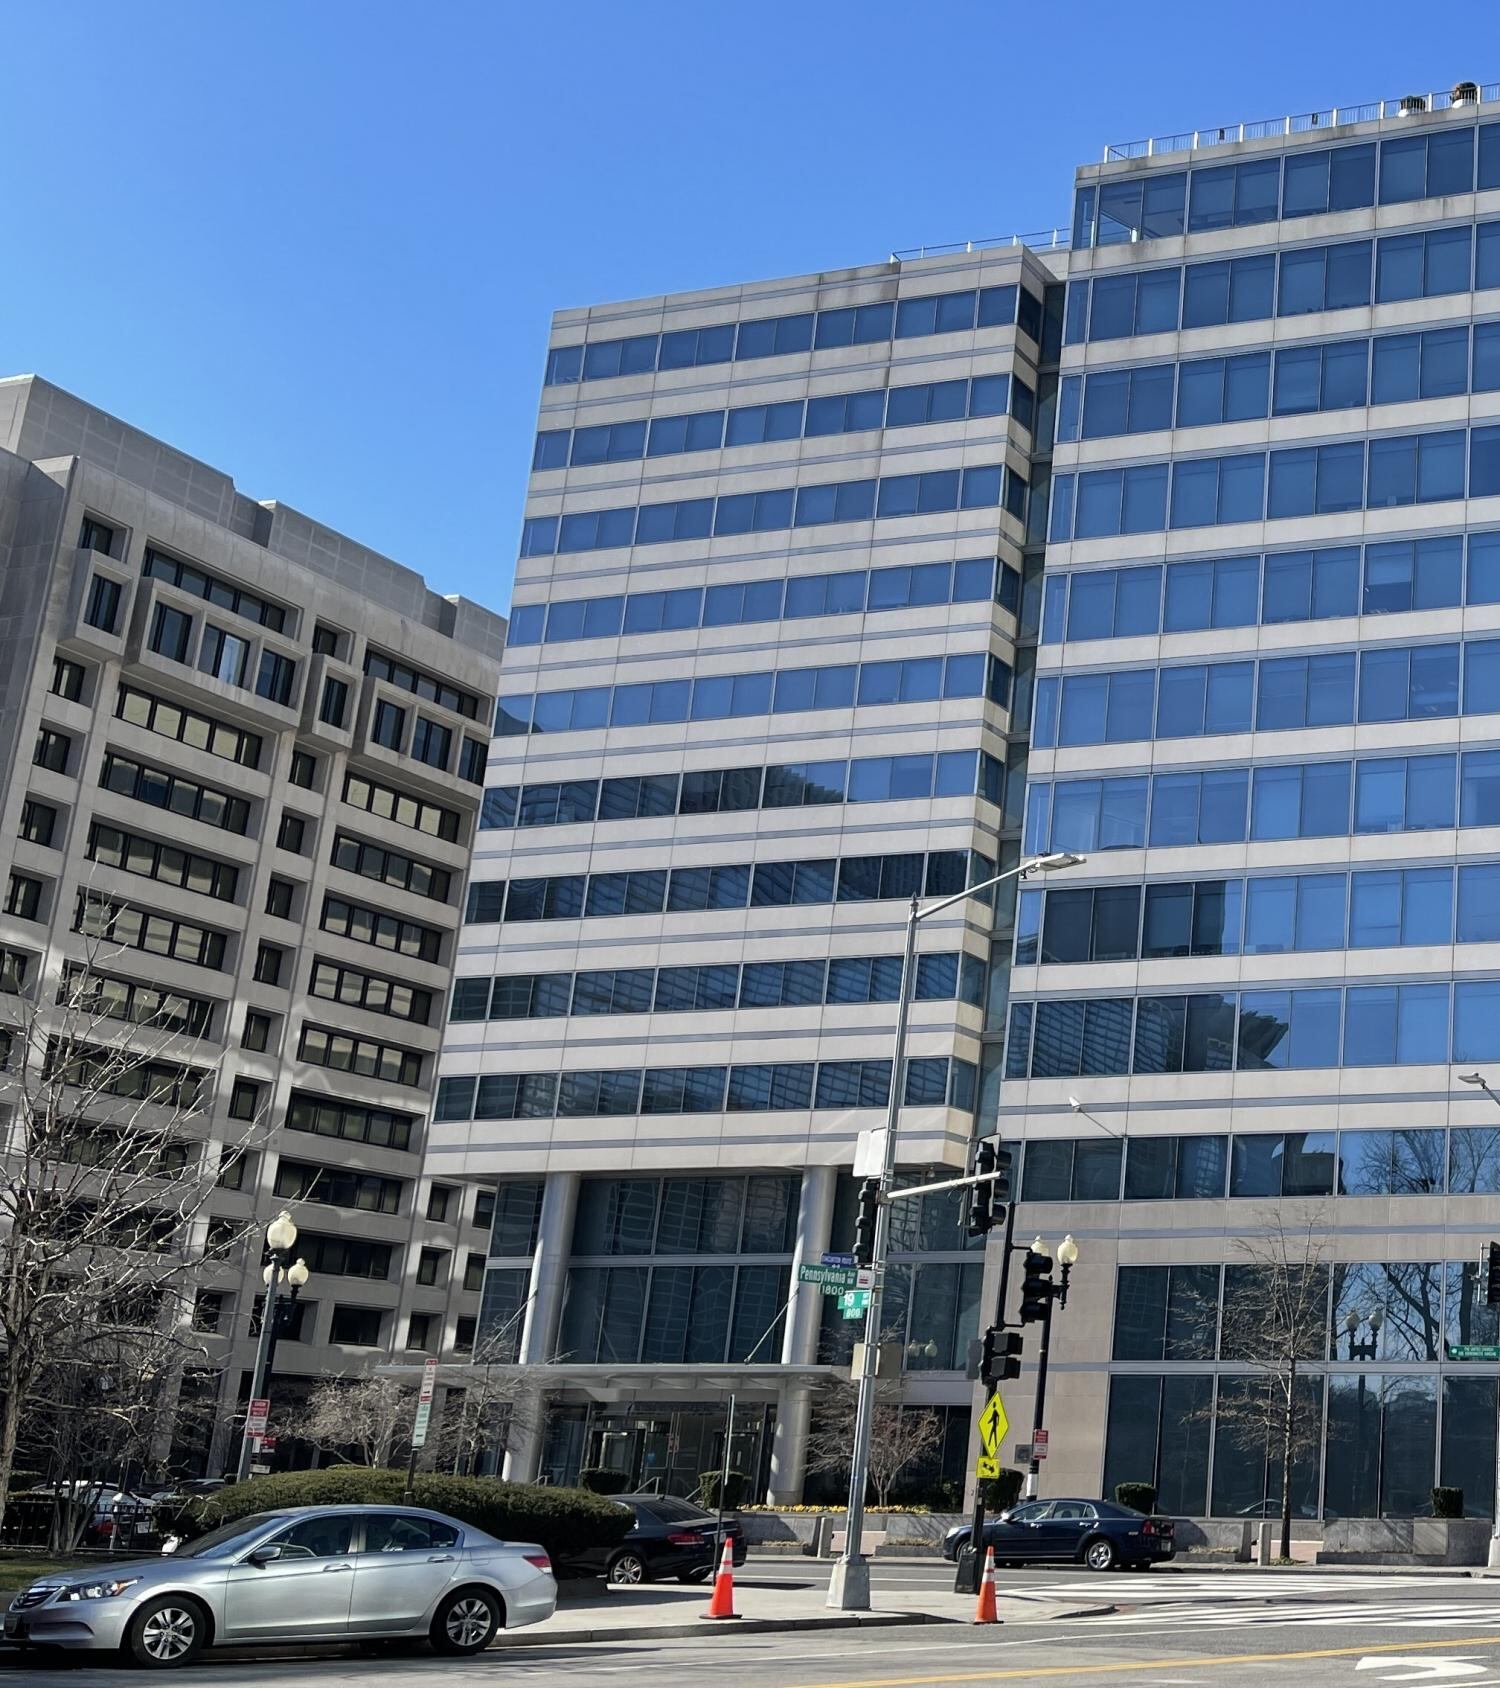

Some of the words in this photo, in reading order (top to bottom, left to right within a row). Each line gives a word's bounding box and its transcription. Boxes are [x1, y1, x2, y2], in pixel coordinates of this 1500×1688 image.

[800, 1266, 846, 1284] Pennsylvania
[822, 1285, 844, 1295] 1800
[844, 1293, 855, 1306] 19
